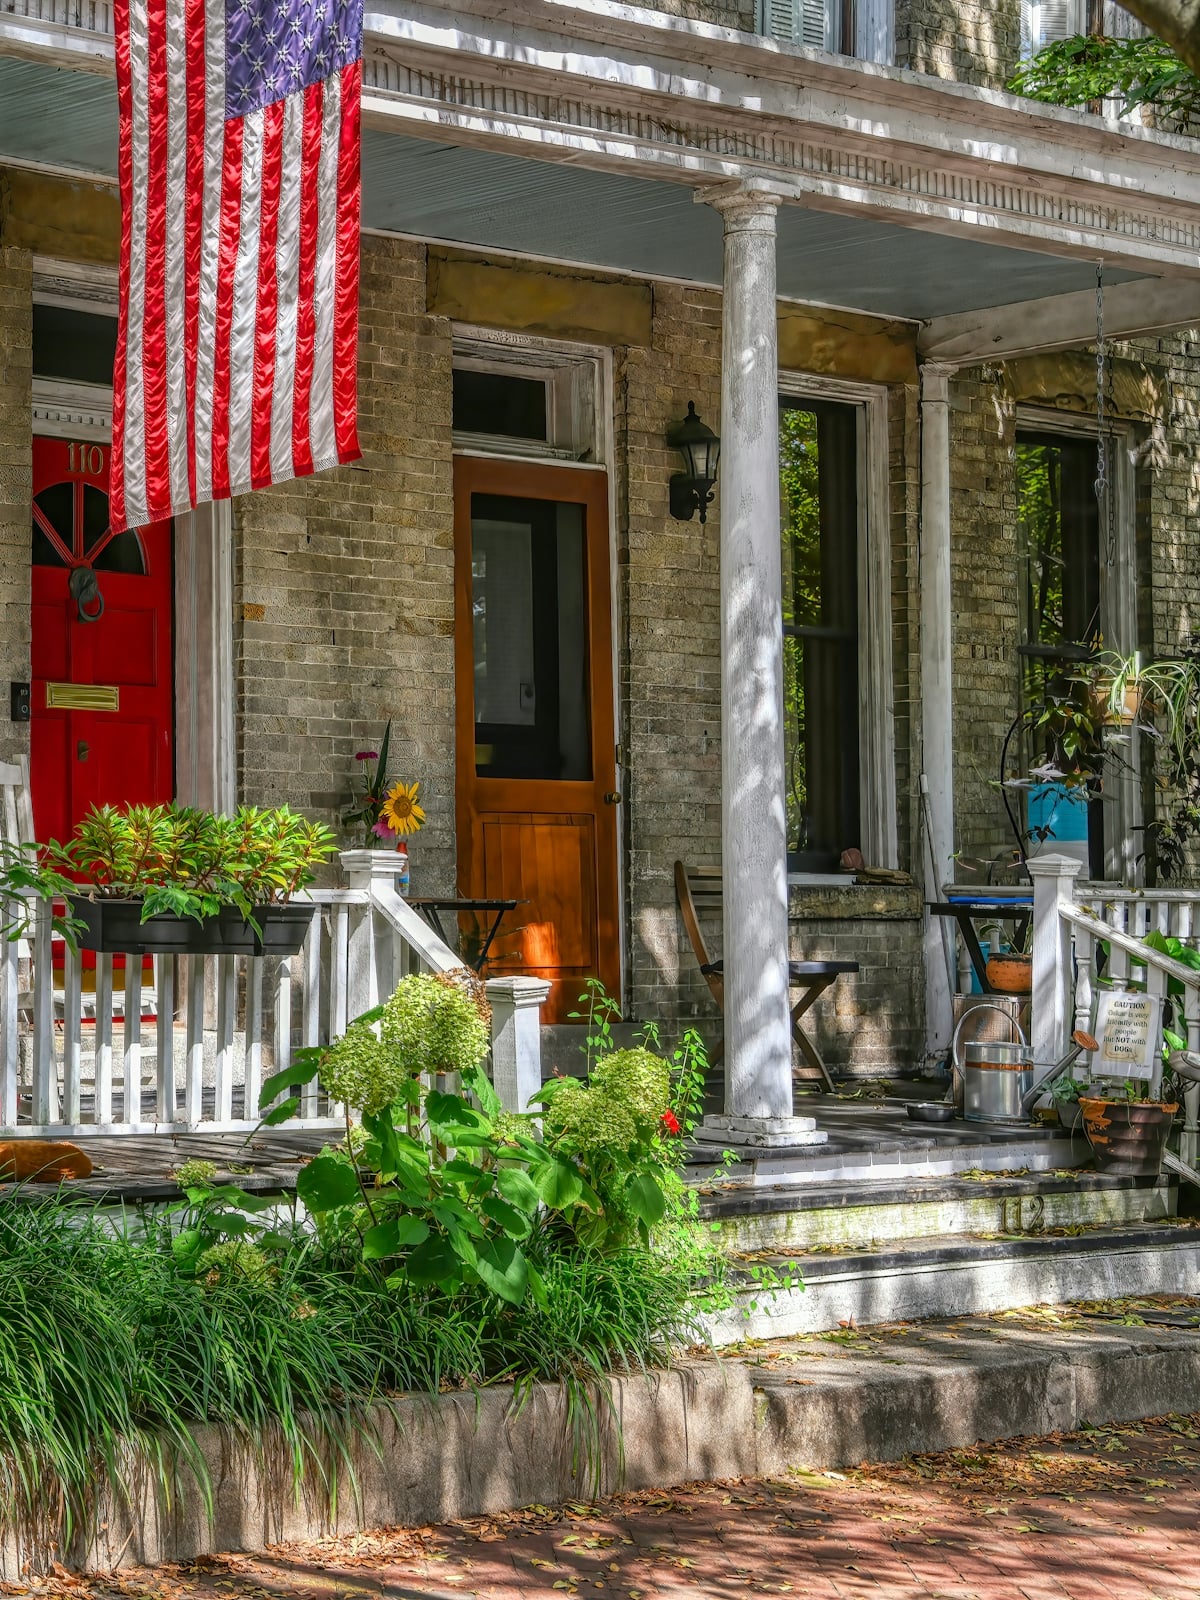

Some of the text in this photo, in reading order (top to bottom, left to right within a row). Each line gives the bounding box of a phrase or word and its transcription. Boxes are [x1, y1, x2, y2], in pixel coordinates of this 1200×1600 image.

[67, 442, 104, 475] 110
[1114, 1001, 1146, 1009] CAUTION
[1133, 1020, 1148, 1028] with
[1115, 1036, 1131, 1044] NOT
[998, 1195, 1046, 1233] 112
